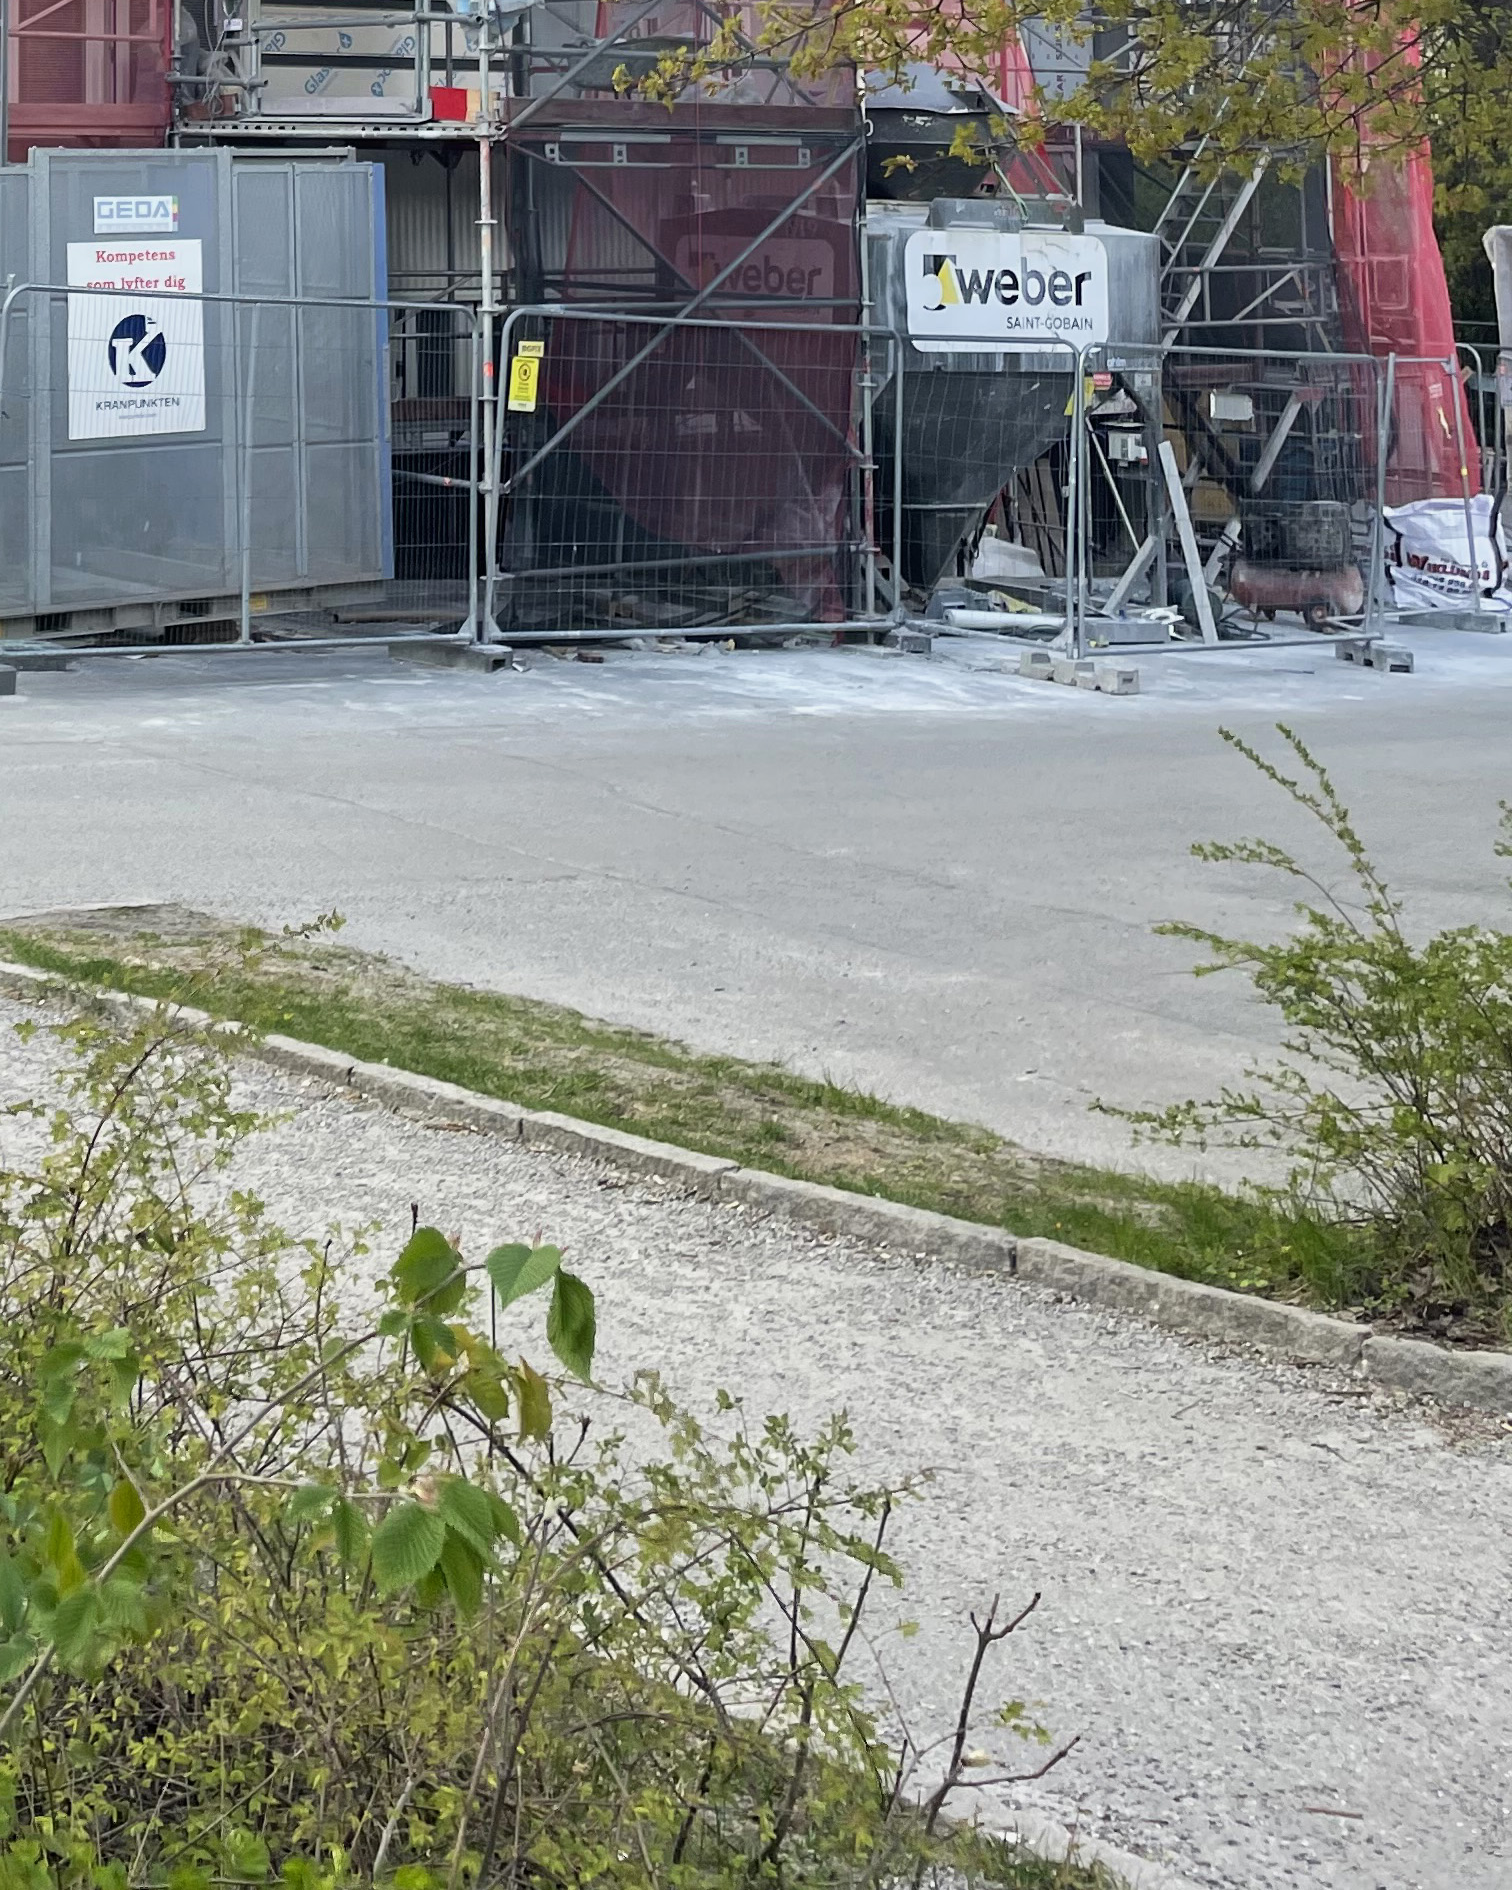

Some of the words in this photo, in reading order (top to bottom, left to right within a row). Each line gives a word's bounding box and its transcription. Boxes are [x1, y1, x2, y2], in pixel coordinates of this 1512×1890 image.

[97, 200, 170, 219] GEDA
[96, 250, 175, 266] Kompetens
[87, 281, 115, 289] som
[121, 276, 159, 290] lyfter
[164, 274, 186, 290] dig
[955, 257, 1092, 306] weber
[1006, 317, 1093, 331] SAINT-GOBAIN
[95, 396, 180, 411] KRANPUNKTEN
